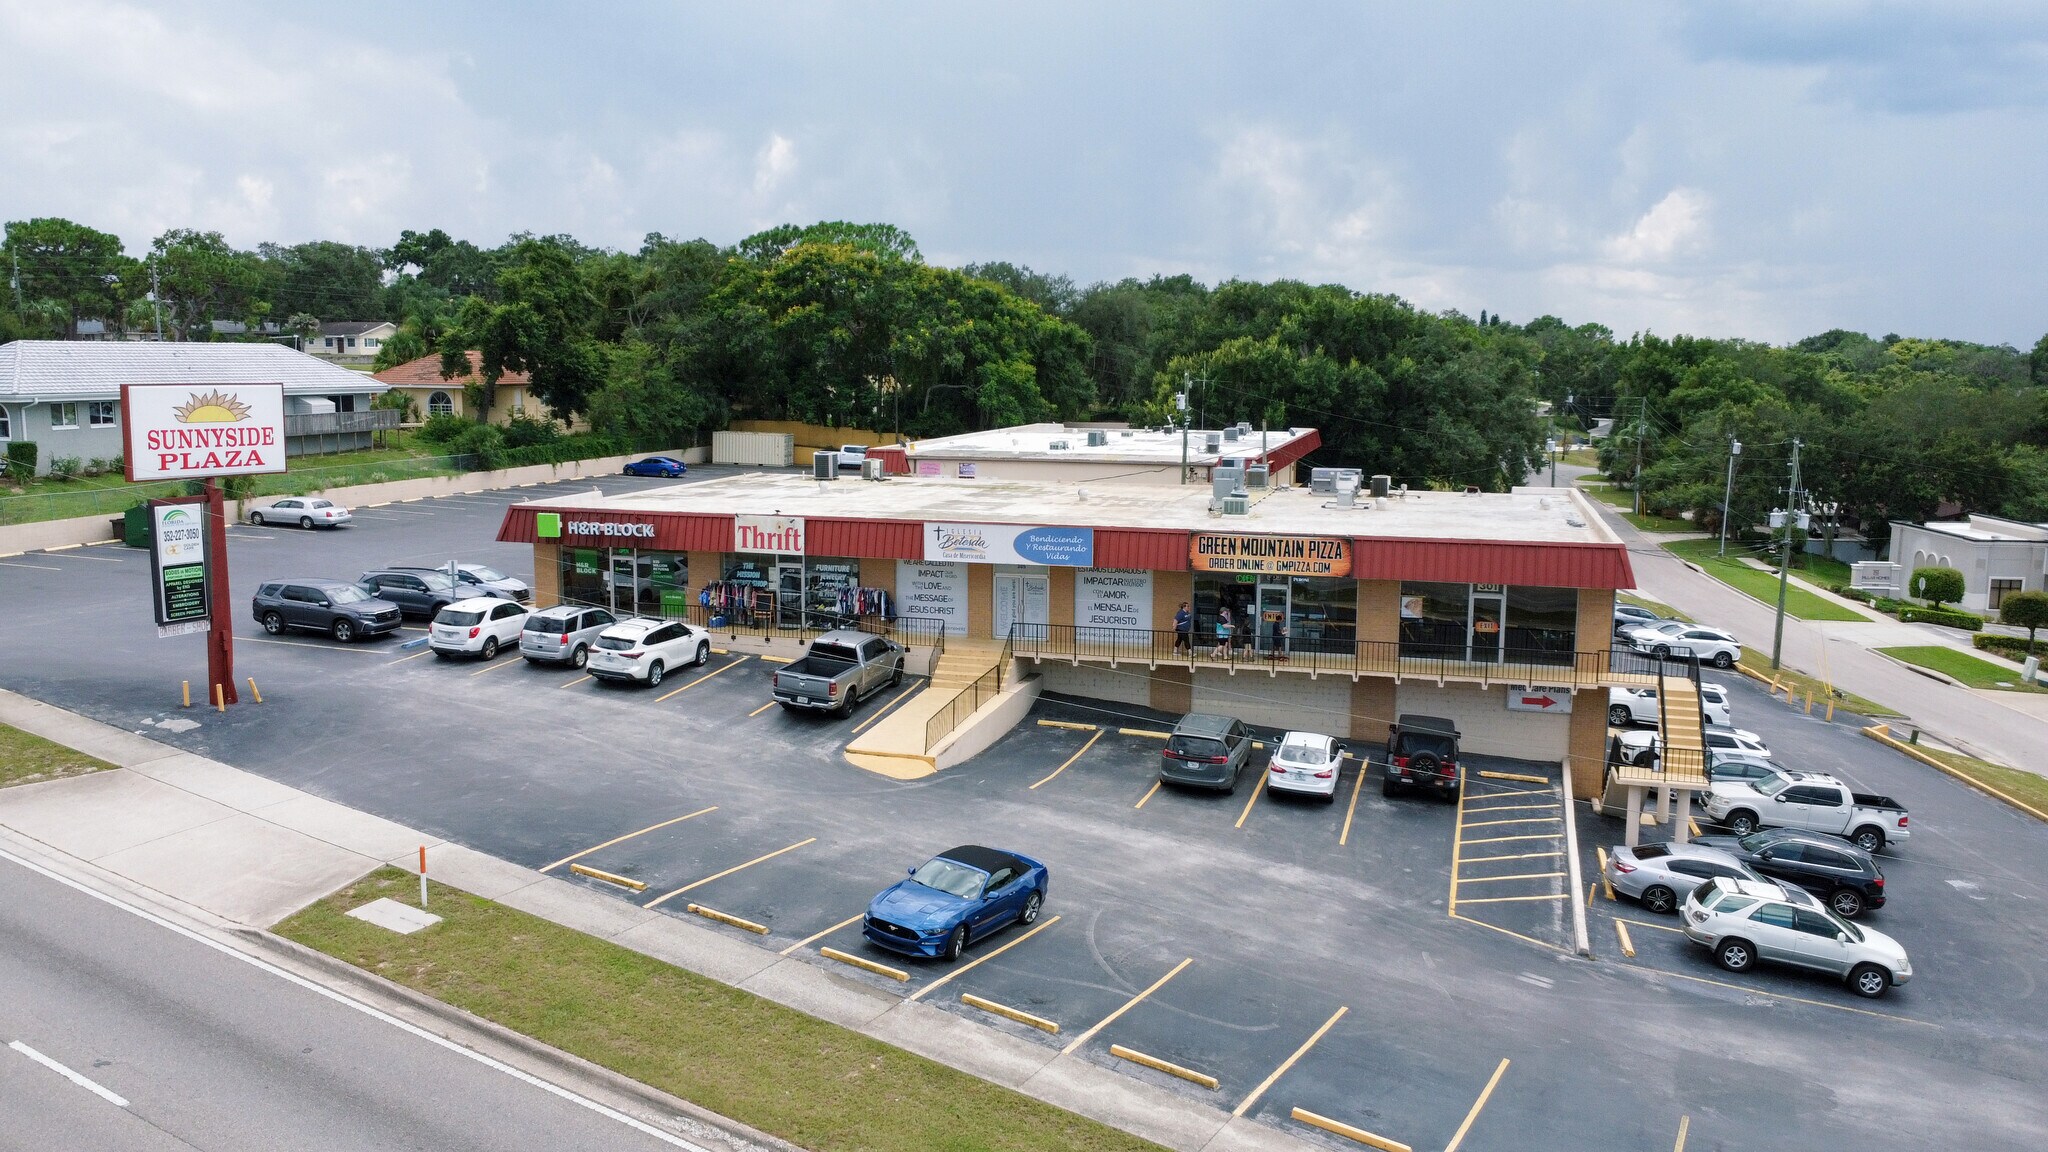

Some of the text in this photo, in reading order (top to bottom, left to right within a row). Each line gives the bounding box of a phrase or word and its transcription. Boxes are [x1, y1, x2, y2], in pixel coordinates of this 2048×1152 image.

[147, 427, 274, 450] SUNNYSIDE
[158, 450, 265, 471] PLAZA
[568, 521, 655, 537] H&R BLOCK
[946, 528, 983, 536] IGLESIA
[163, 528, 199, 542] 352-227-3050
[738, 525, 802, 552] Thrift
[1030, 535, 1083, 544] Bendiciendo
[938, 534, 991, 549] Betesda
[1032, 543, 1088, 553] Restaurando
[1199, 536, 1343, 560] GREEN MOUNTAIN PIZZA
[959, 552, 986, 560] Misericordia
[1045, 552, 1071, 561] Vidas
[743, 562, 754, 570] THE
[816, 564, 850, 572] FURNITURE
[1208, 557, 1235, 570] ORDER
[1237, 558, 1265, 571] ONLINE
[1276, 560, 1331, 573] GMPIZZA.COM
[820, 573, 847, 581] JEWELRY
[918, 569, 944, 578] IMPACT
[1083, 577, 1124, 586] IMPACTAR
[1236, 575, 1256, 583] OPEN
[752, 580, 768, 588] SHOP
[923, 582, 942, 590] LOVE
[914, 594, 948, 603] MESSAGE
[1103, 591, 1126, 599] AMOR
[906, 605, 955, 614] JESUS CHRIST
[1000, 586, 1009, 630] WELCOME
[1094, 603, 1133, 613] MENSAJE
[1089, 615, 1137, 625] JESUCRISTO
[159, 624, 185, 637] BARBER
[193, 621, 210, 632] SHOP
[1549, 686, 1571, 694] Plans
